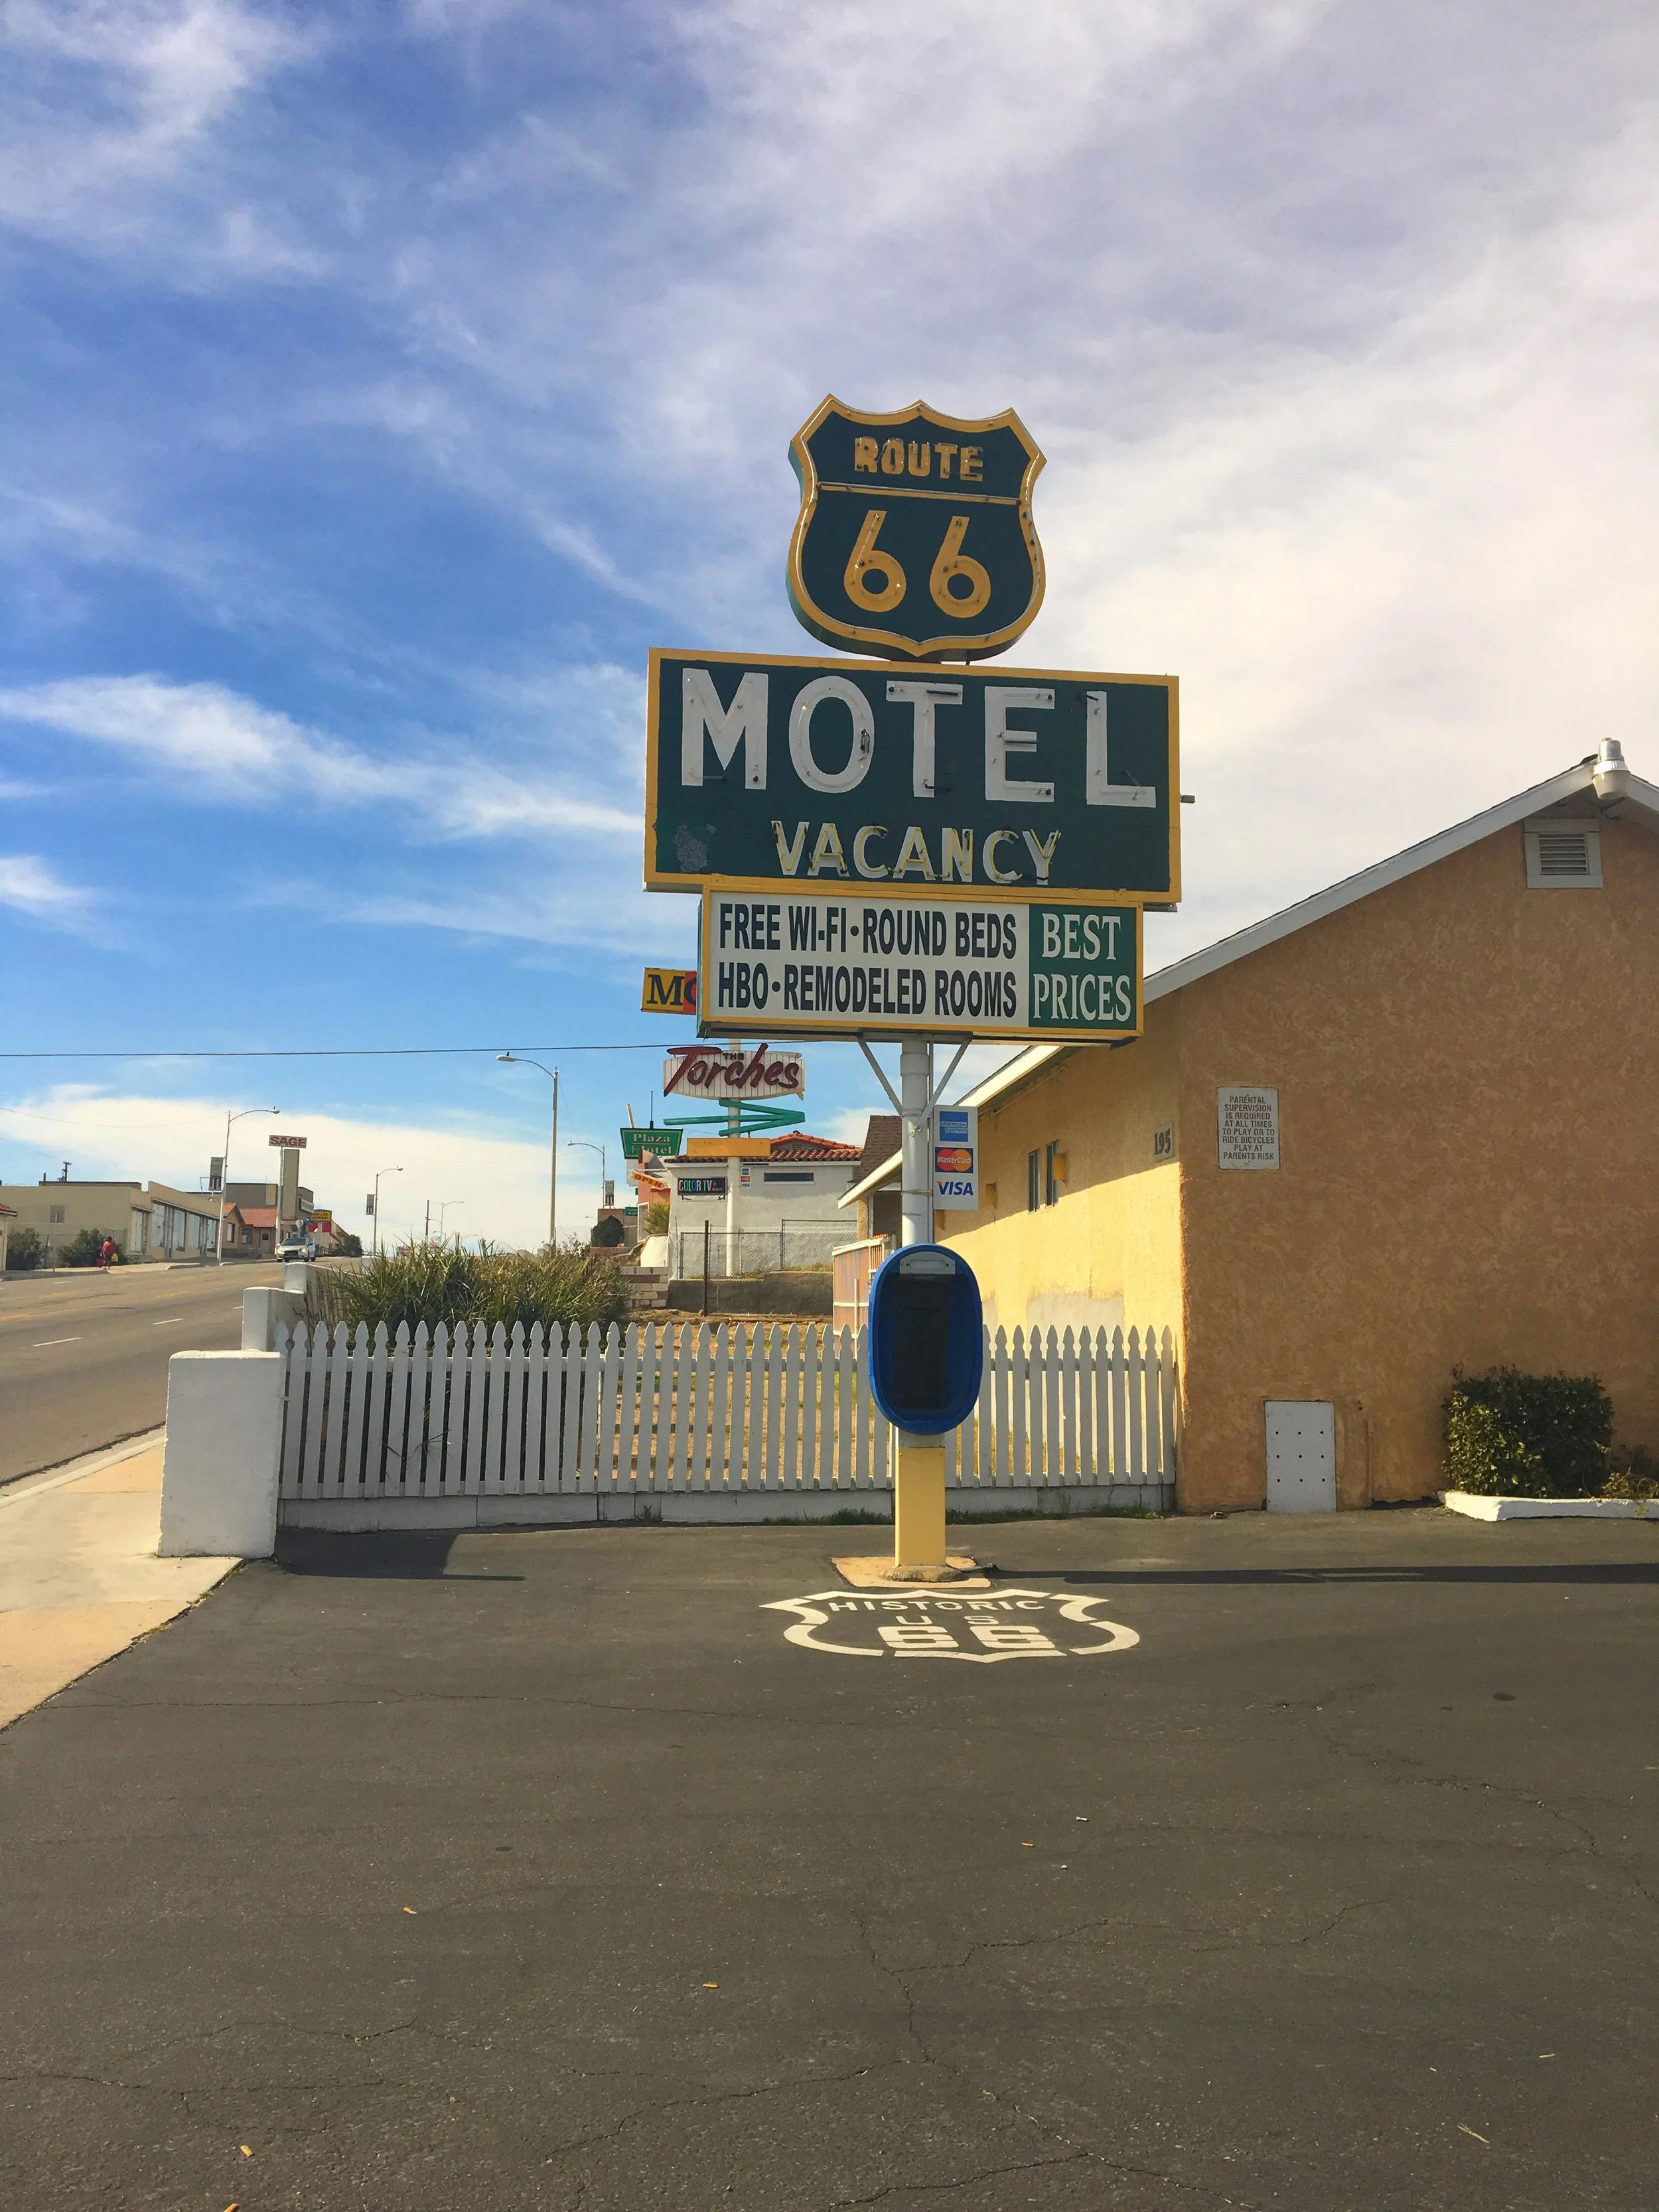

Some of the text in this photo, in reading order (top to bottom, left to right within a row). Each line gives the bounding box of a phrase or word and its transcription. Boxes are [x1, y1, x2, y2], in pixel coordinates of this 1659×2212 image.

[854, 436, 983, 482] ROUTE
[843, 510, 991, 619] 66
[681, 668, 1156, 808] MOTEL
[771, 820, 1061, 885] VACANCY
[720, 903, 780, 950] FREE
[863, 908, 947, 956] ROUND
[956, 912, 1017, 959] BEDS
[1042, 913, 1121, 960] BEST
[719, 962, 1017, 1017] HBO REMODELED ROOMS
[1033, 973, 1131, 1022] PRICES
[664, 1043, 800, 1097] Torches
[270, 1136, 306, 1146] SAGE
[633, 1134, 670, 1142] Plaza
[1154, 1128, 1171, 1155] 195
[634, 1174, 662, 1188] OPEN
[679, 1180, 701, 1192] COLOR
[703, 1180, 712, 1192] TV
[937, 1181, 974, 1195] VISA
[828, 1601, 1045, 1611] HISTORIC
